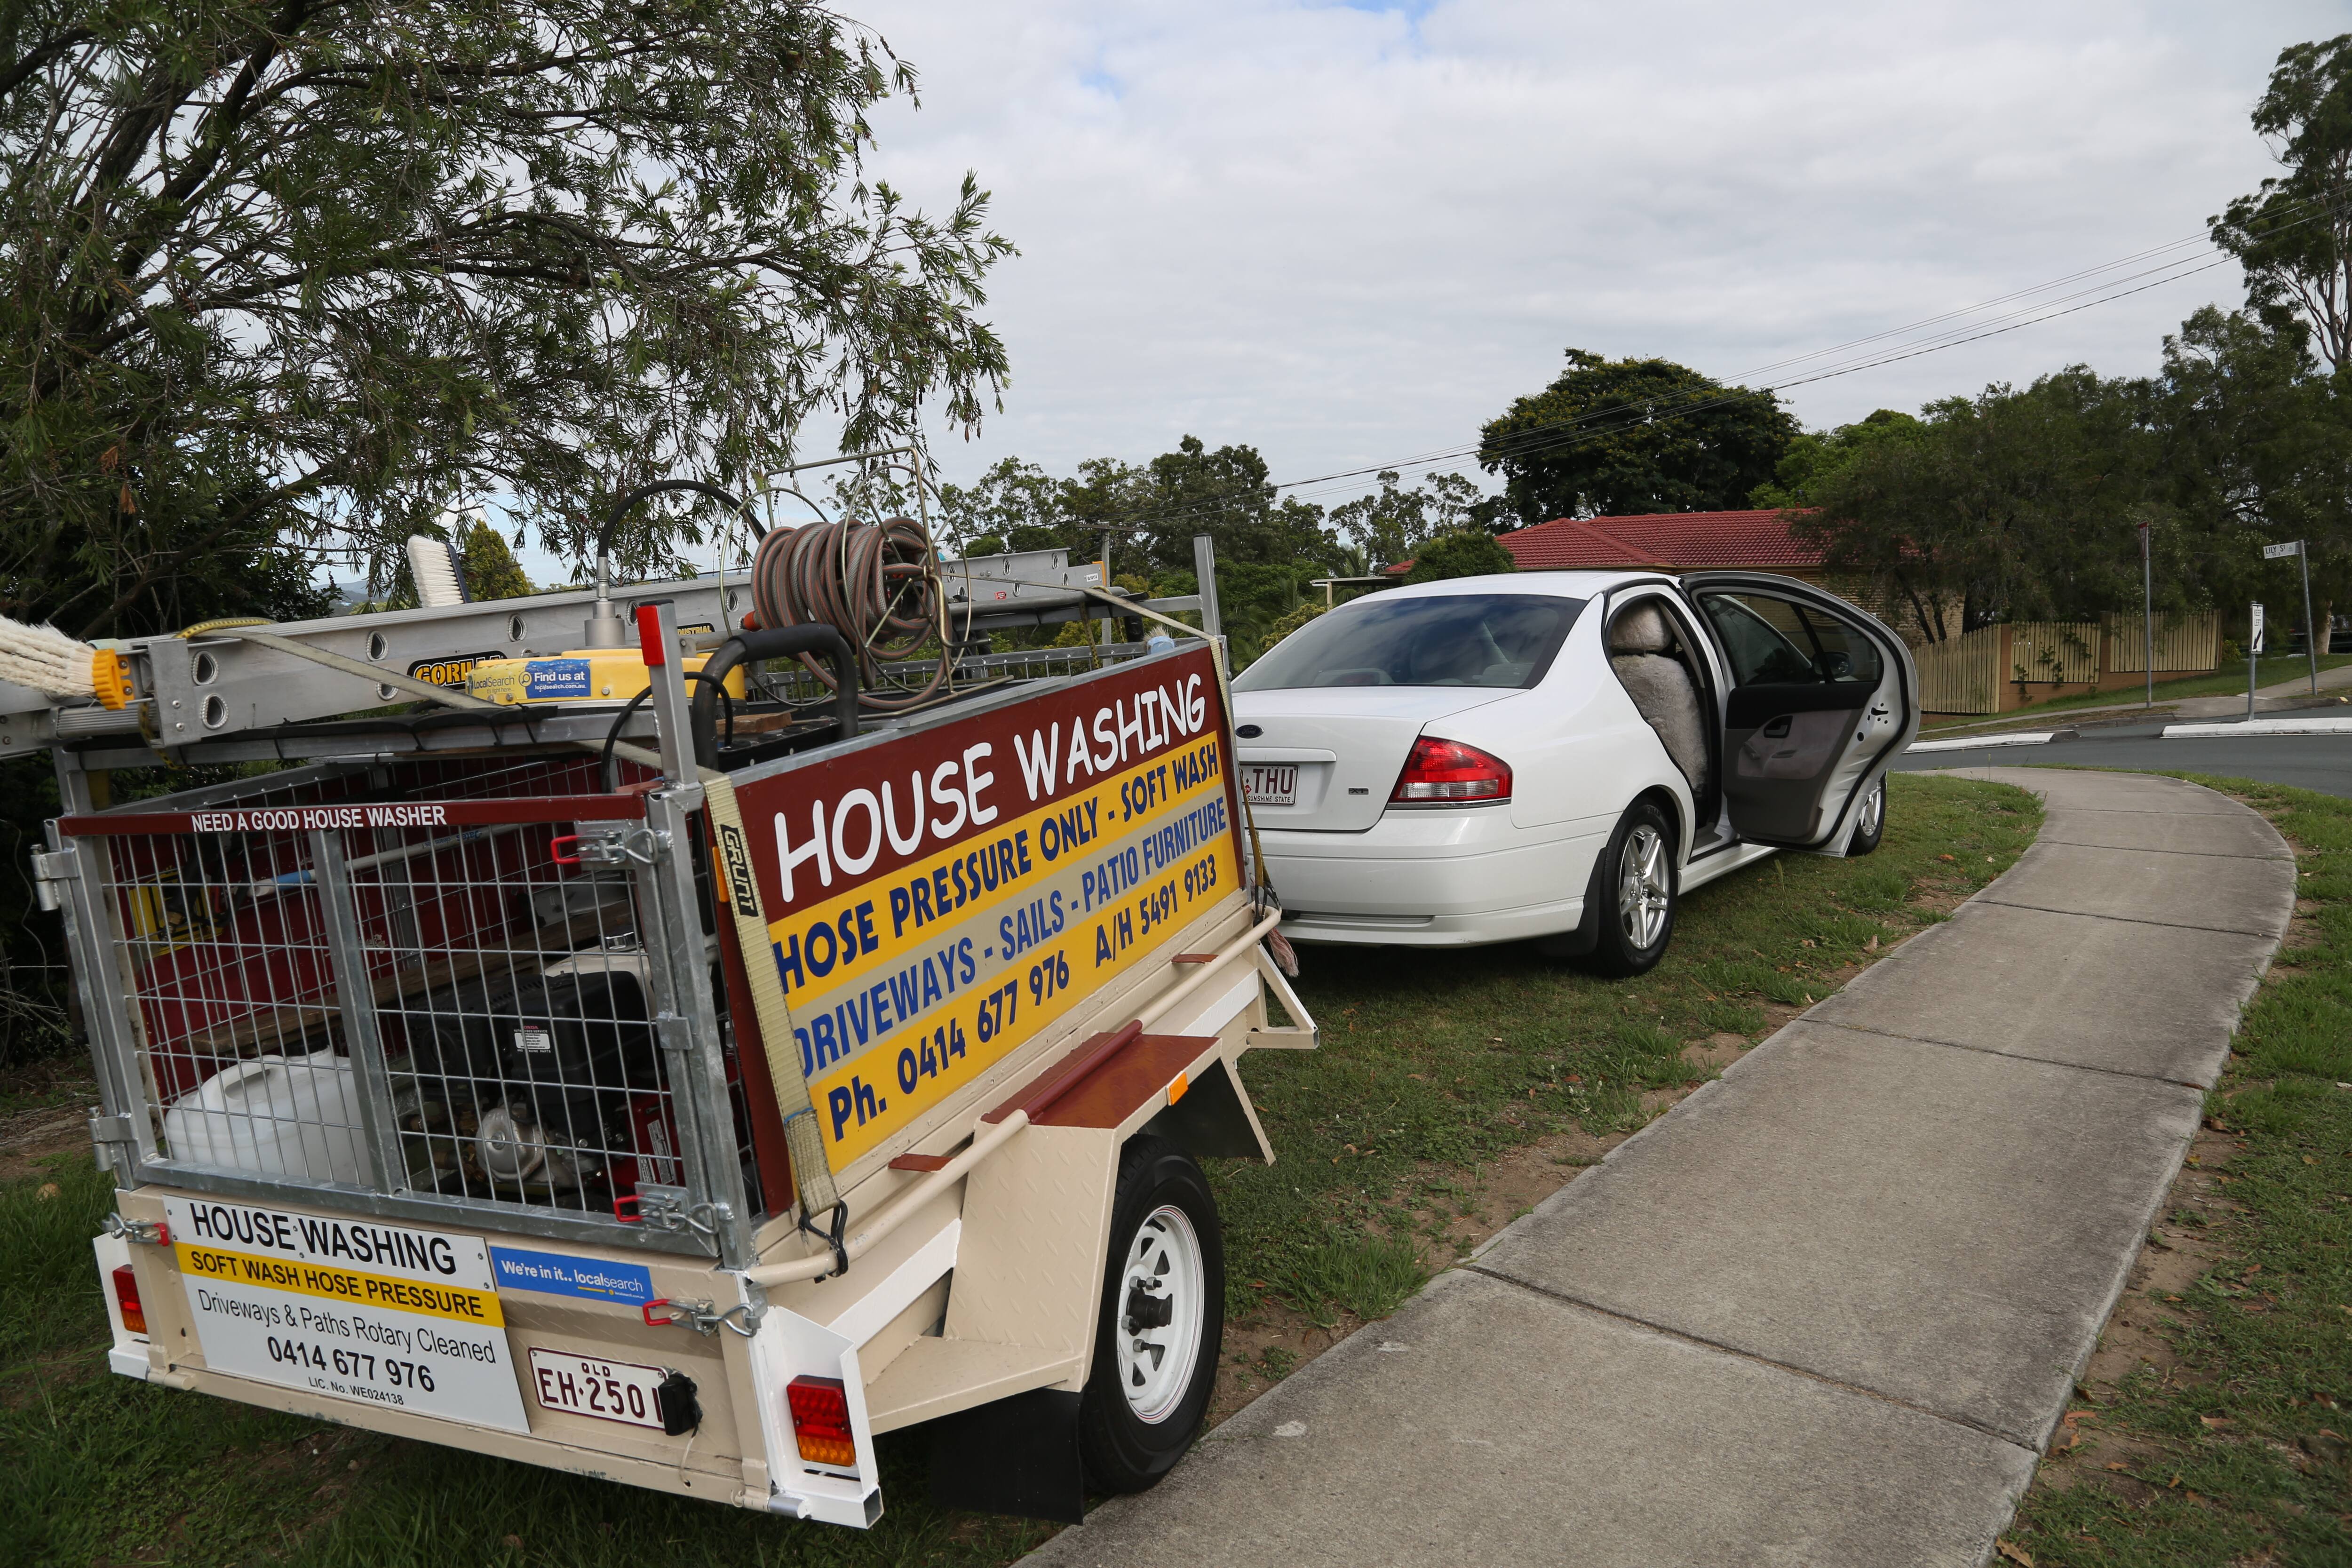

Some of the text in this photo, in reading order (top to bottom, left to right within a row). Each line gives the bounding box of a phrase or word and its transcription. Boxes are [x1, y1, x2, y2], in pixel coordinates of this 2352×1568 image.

[2265, 546, 2277, 554] LILY
[677, 625, 712, 636] DUSTRIAL
[414, 655, 501, 686] GORIL
[473, 675, 515, 689] LocalSearch
[534, 671, 556, 682] Find
[574, 671, 586, 681] at
[773, 673, 1205, 903] HOUSE WASHING
[191, 805, 447, 833] NEED A GOOD HOUSE WASHER
[773, 900, 879, 995] HOSE
[889, 830, 1032, 940] PRESSURE
[1039, 796, 1098, 862] ONLY
[1121, 765, 1168, 823] SOFT
[1173, 741, 1219, 794] WASH
[794, 937, 976, 1079] DRIVEWAYS
[998, 890, 1064, 962] SAILS
[1082, 851, 1138, 914] PATIO
[1142, 795, 1227, 870] FURNITURE
[828, 853, 1216, 1142] Ph. 0414 677 976 A/H 5491 9133
[189, 1202, 457, 1275] HOUSE WASHING
[191, 1250, 485, 1318] SOFT WASH HOSE PRESSURE
[501, 1259, 538, 1278] We're
[539, 1264, 552, 1279] in
[574, 1270, 644, 1293] localsearch
[198, 1289, 497, 1364] Driveways & Paths Rotary Cleaned
[267, 1336, 436, 1393] 0414 677 976
[581, 1361, 611, 1377] QLD
[308, 1376, 405, 1406] LIC. No. WE024138
